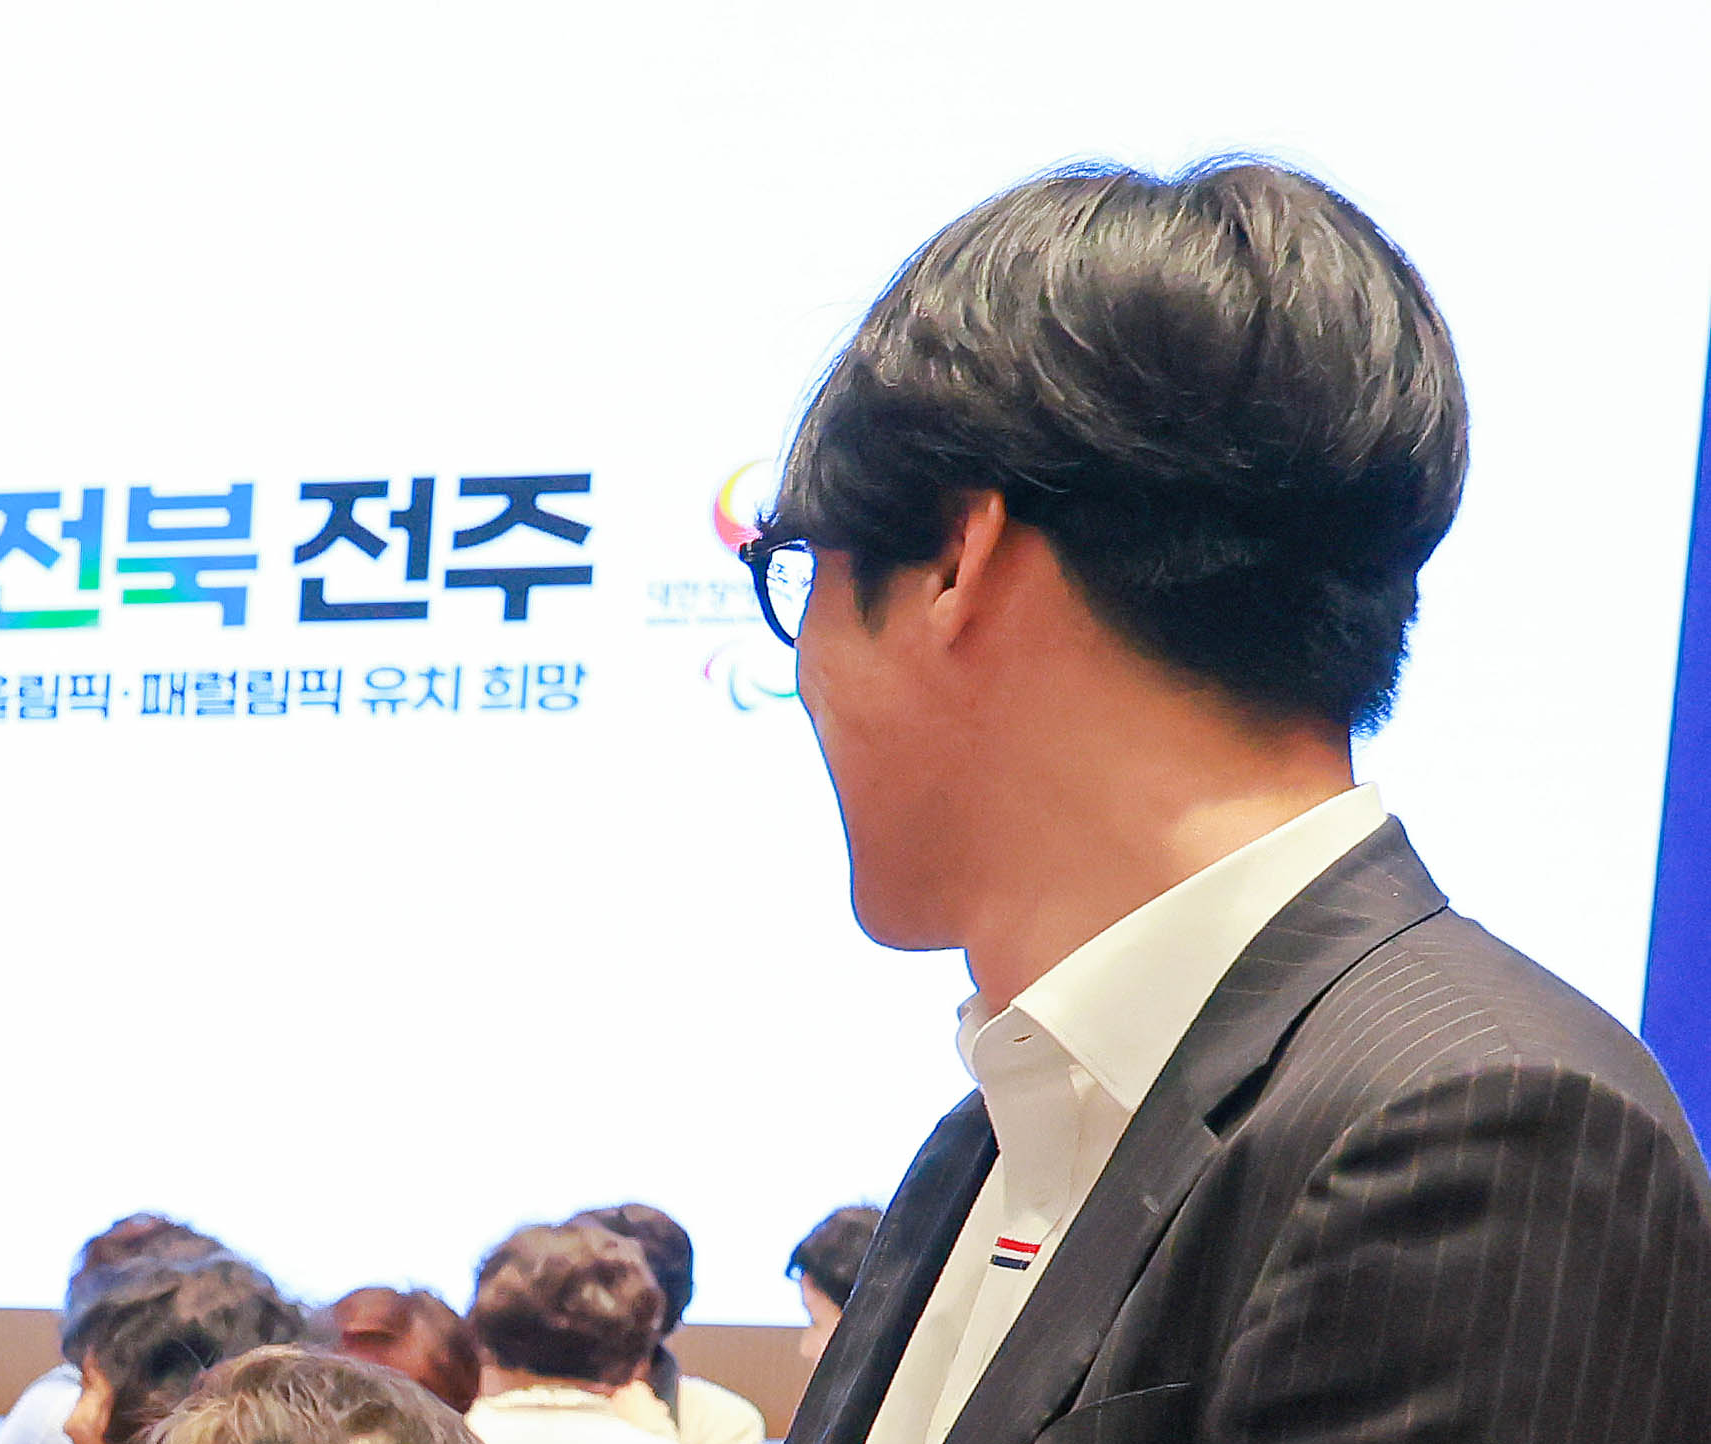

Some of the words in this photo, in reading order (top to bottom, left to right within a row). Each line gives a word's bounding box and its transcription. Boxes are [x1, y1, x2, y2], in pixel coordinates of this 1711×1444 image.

[293, 473, 594, 623] 전주
[361, 664, 462, 715] 유치
[478, 663, 587, 713] 희망
